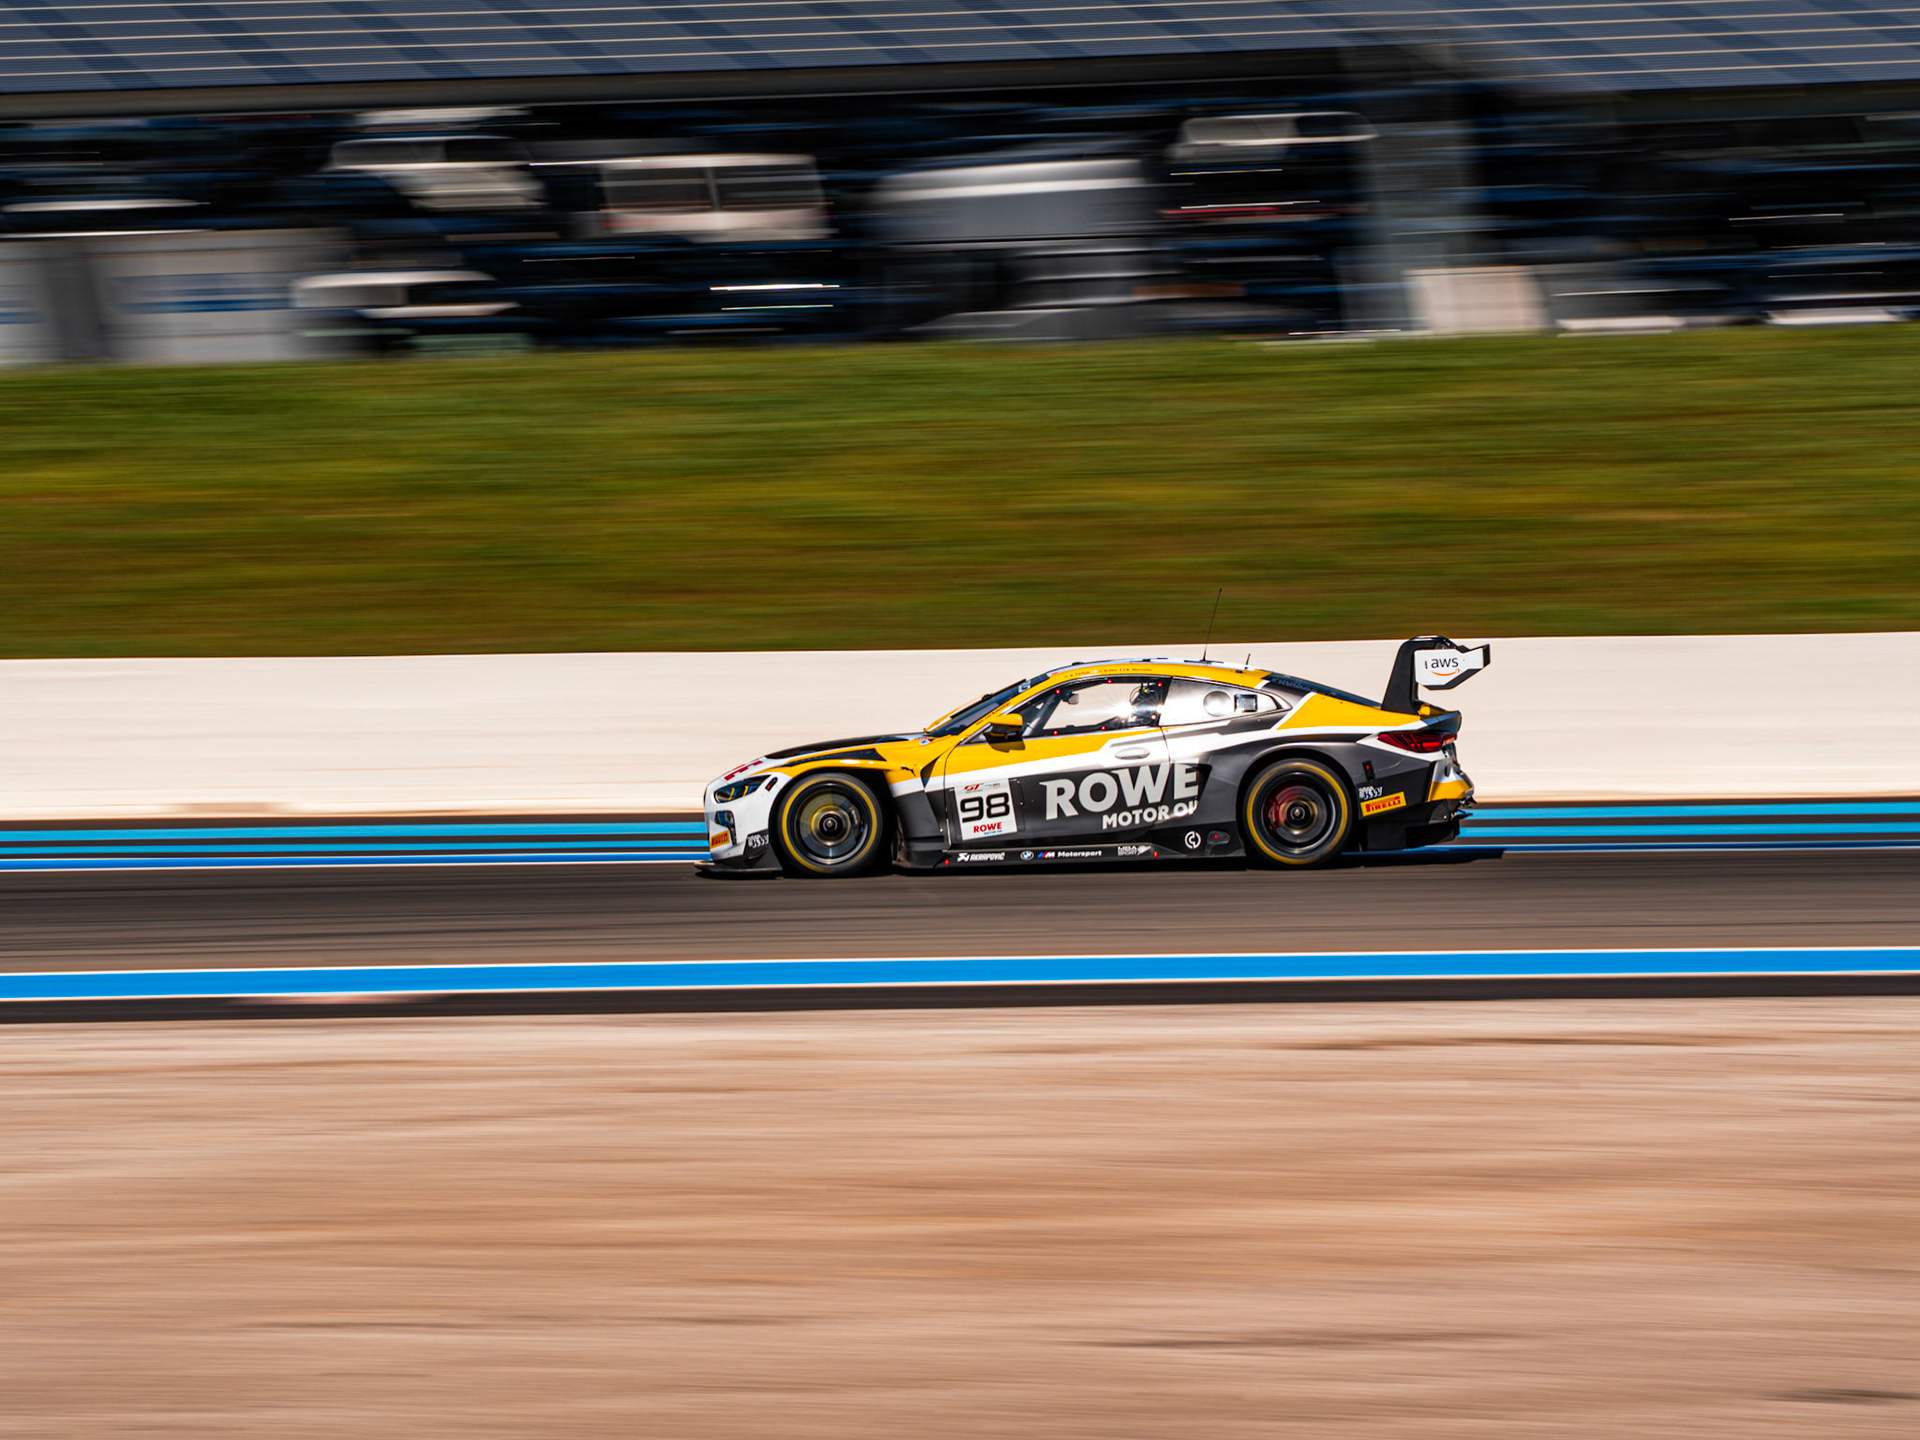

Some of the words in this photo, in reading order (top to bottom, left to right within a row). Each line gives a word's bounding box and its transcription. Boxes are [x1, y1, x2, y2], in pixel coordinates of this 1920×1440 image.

[1431, 657, 1459, 669] aws
[1039, 757, 1199, 820] ROWE
[960, 792, 1010, 823] 98
[1102, 804, 1170, 830] MOTOR
[973, 821, 1002, 833] ROWE
[1057, 850, 1102, 858] Motorsport
